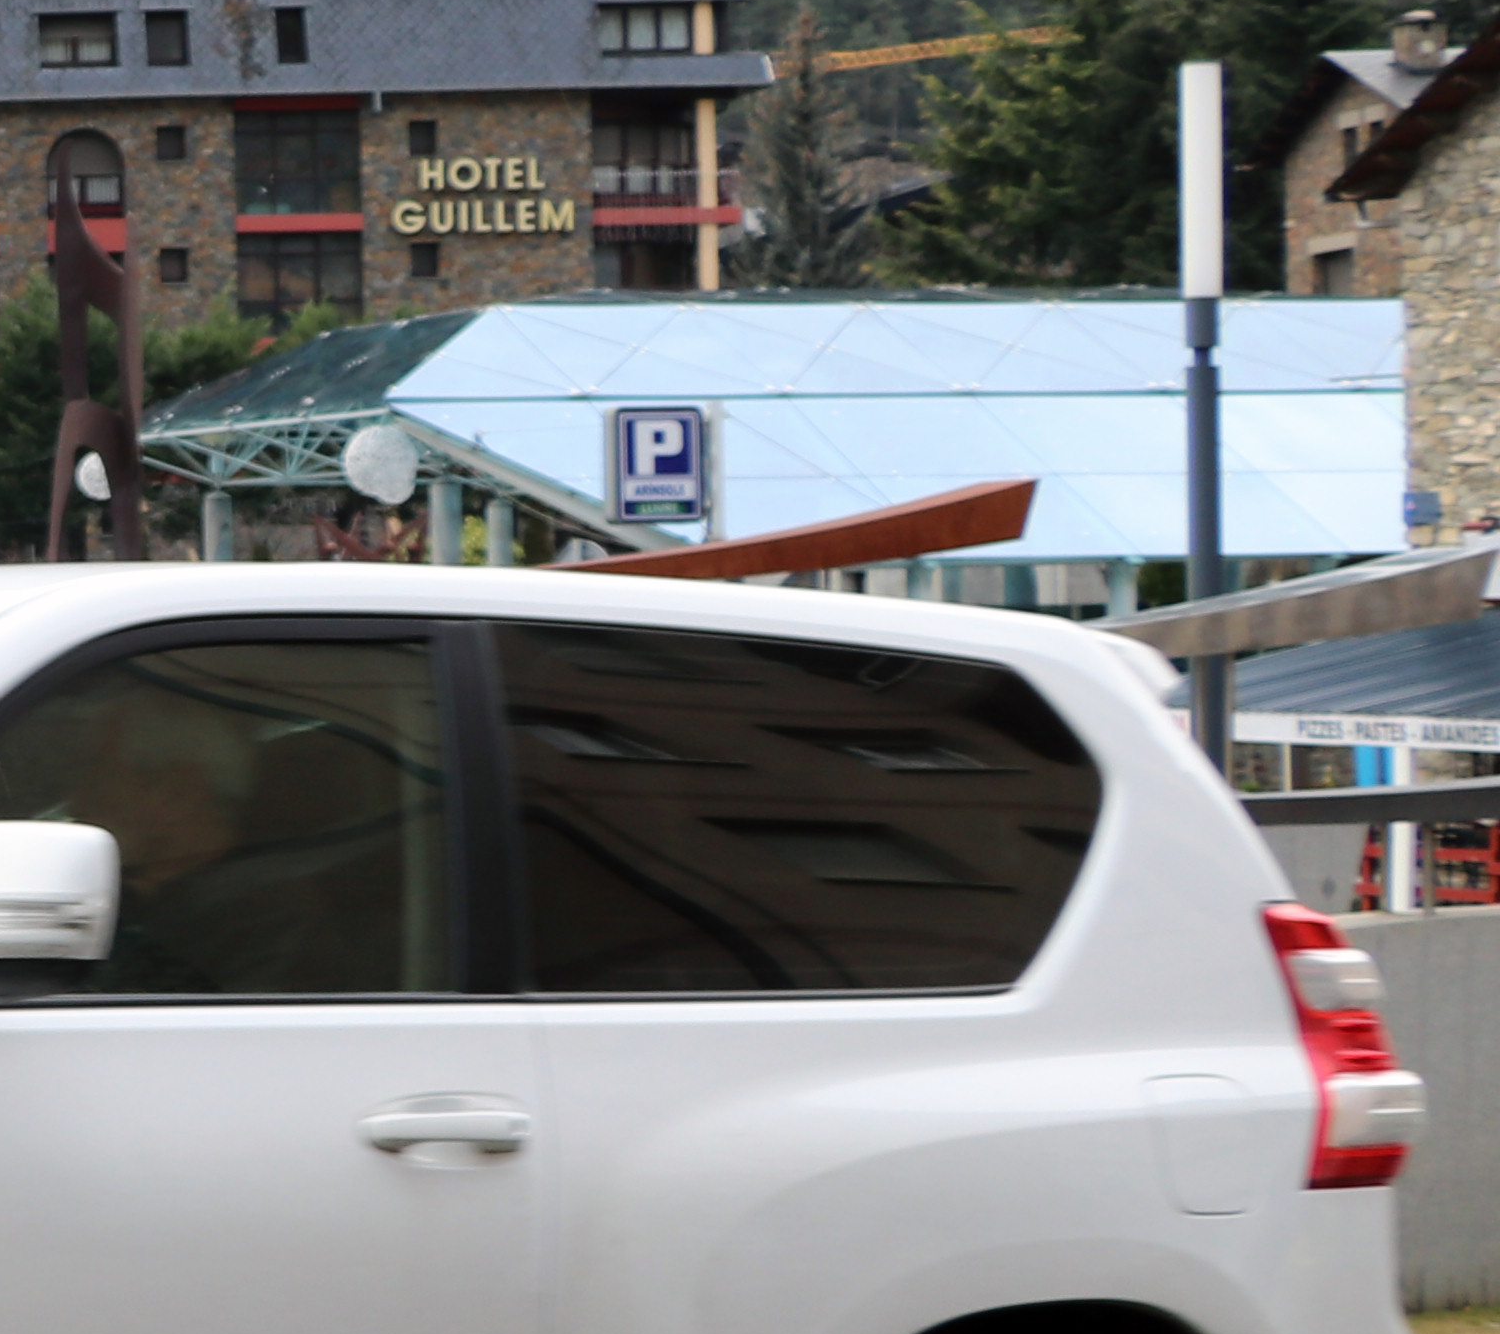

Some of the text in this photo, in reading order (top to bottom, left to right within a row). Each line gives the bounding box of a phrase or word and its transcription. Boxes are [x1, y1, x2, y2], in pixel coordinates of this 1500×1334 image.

[418, 156, 546, 191] HOTEL
[390, 198, 576, 235] GUILLEM
[635, 419, 684, 474] P
[1299, 719, 1500, 747] PIZZES PASTES AMANIDES
